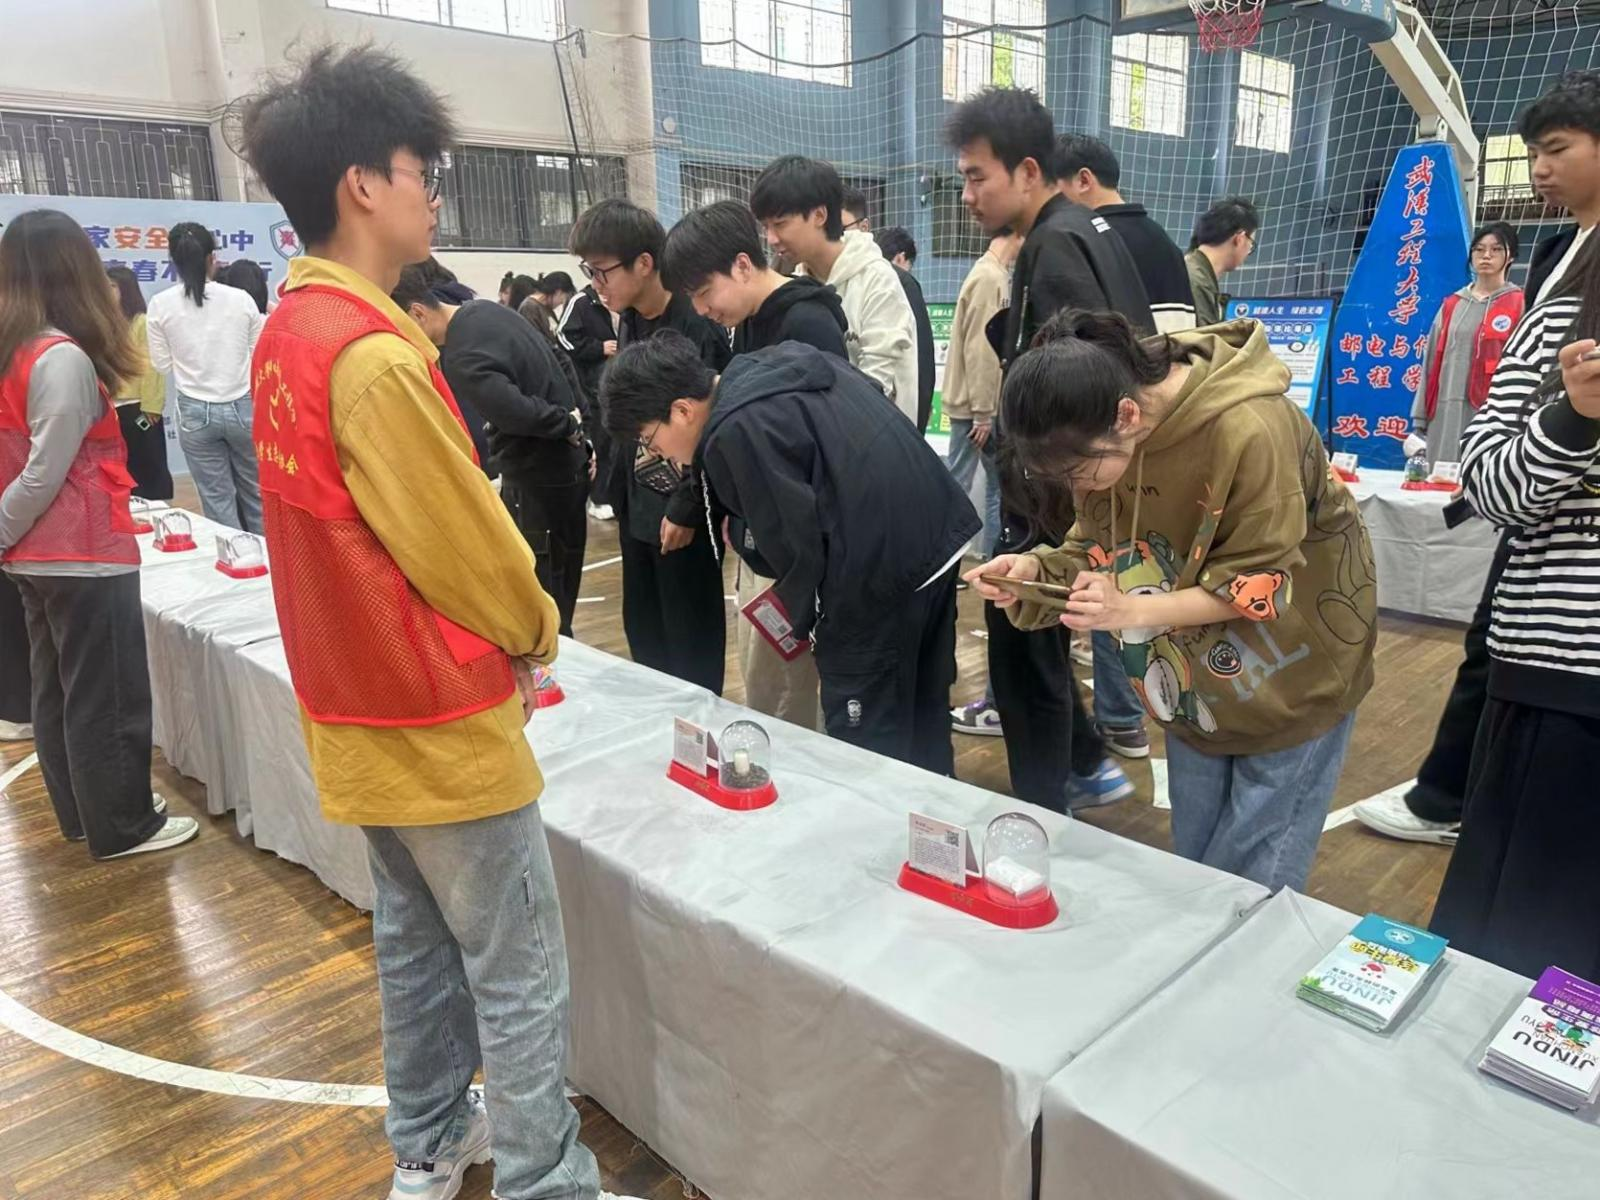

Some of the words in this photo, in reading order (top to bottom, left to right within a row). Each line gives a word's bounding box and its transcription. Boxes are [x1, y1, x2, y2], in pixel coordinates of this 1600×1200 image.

[84, 226, 254, 251] 家安全心中
[1332, 414, 1409, 440] 欢迎
[1321, 974, 1393, 1006] JINDU
[1512, 1030, 1595, 1070] JINDU
